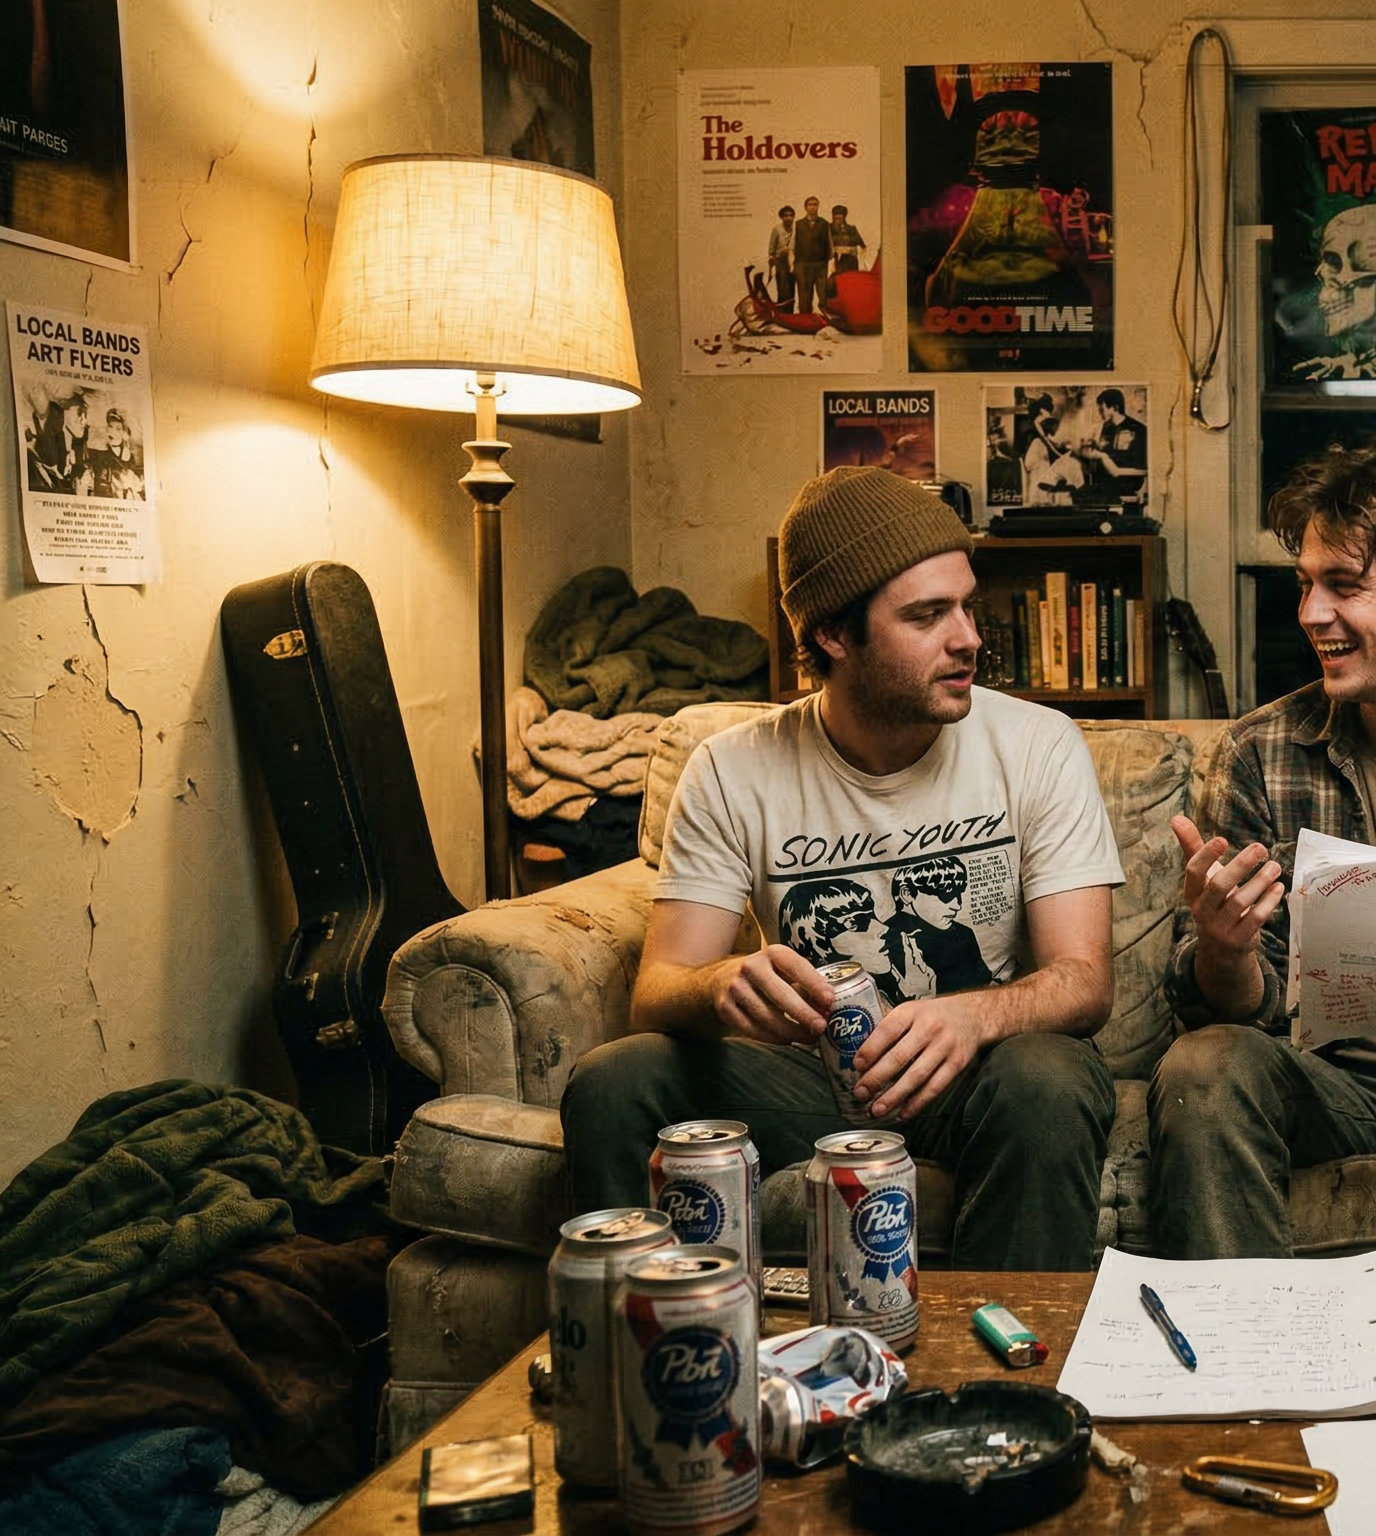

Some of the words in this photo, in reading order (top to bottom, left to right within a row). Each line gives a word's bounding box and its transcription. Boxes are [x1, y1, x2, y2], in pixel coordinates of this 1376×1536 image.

[22, 124, 69, 154] PARGES
[700, 115, 744, 134] The
[702, 135, 858, 161] Holdovers
[16, 313, 78, 343] LOCAL
[82, 326, 140, 355] BANDS
[27, 341, 64, 365] ART
[69, 348, 133, 376] FLYERS
[829, 398, 873, 414] LOCAL
[876, 397, 930, 414] BANDS
[775, 832, 892, 869] SONIC
[898, 810, 1006, 856] YOUTH
